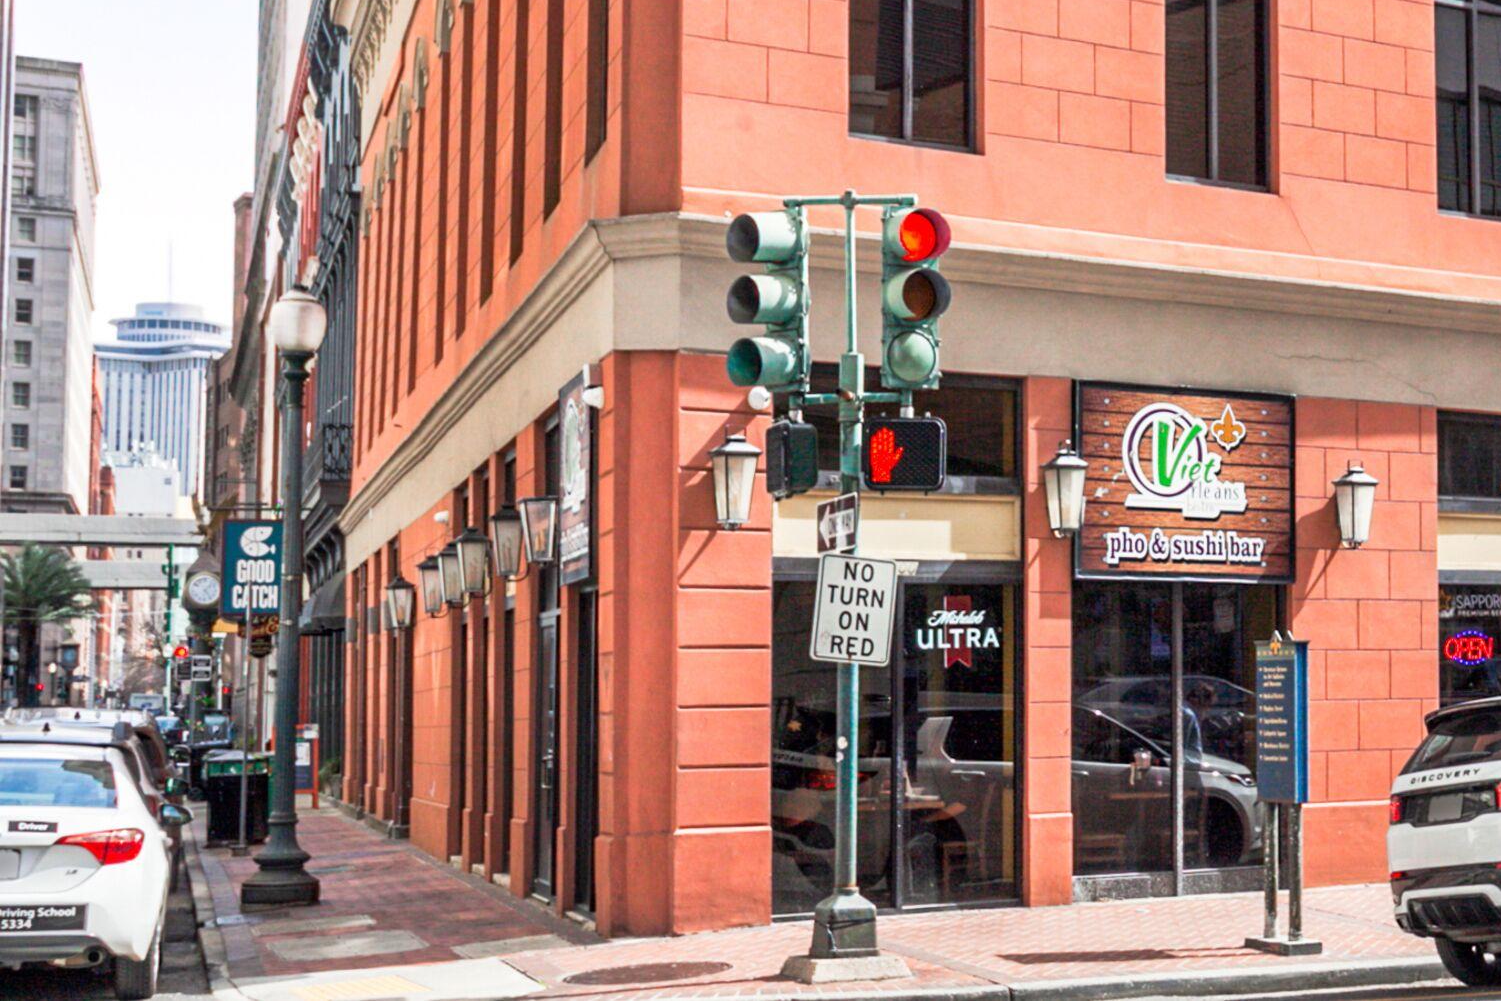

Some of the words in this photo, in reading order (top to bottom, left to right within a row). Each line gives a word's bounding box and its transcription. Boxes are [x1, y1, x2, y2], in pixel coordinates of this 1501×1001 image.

[1157, 420, 1215, 488] Viet
[1110, 531, 1146, 559] pho
[1152, 531, 1167, 555] &
[1173, 535, 1225, 557] sushi
[1230, 535, 1262, 558] bar
[236, 559, 276, 584] GOOD
[843, 561, 875, 583] NO
[231, 585, 279, 610] CATCH
[827, 584, 885, 609] TURN
[838, 610, 870, 632] ON
[927, 610, 987, 626] Michelob
[1457, 609, 1490, 617] PREMIUM
[830, 635, 875, 658] RED
[916, 627, 1000, 650] ULTRA
[1444, 636, 1494, 659] OPEN
[1410, 767, 1481, 786] DISCOVERY
[17, 822, 49, 831] Driver
[0, 907, 35, 919] riving
[37, 906, 77, 917] School
[1, 919, 32, 930] 5334
